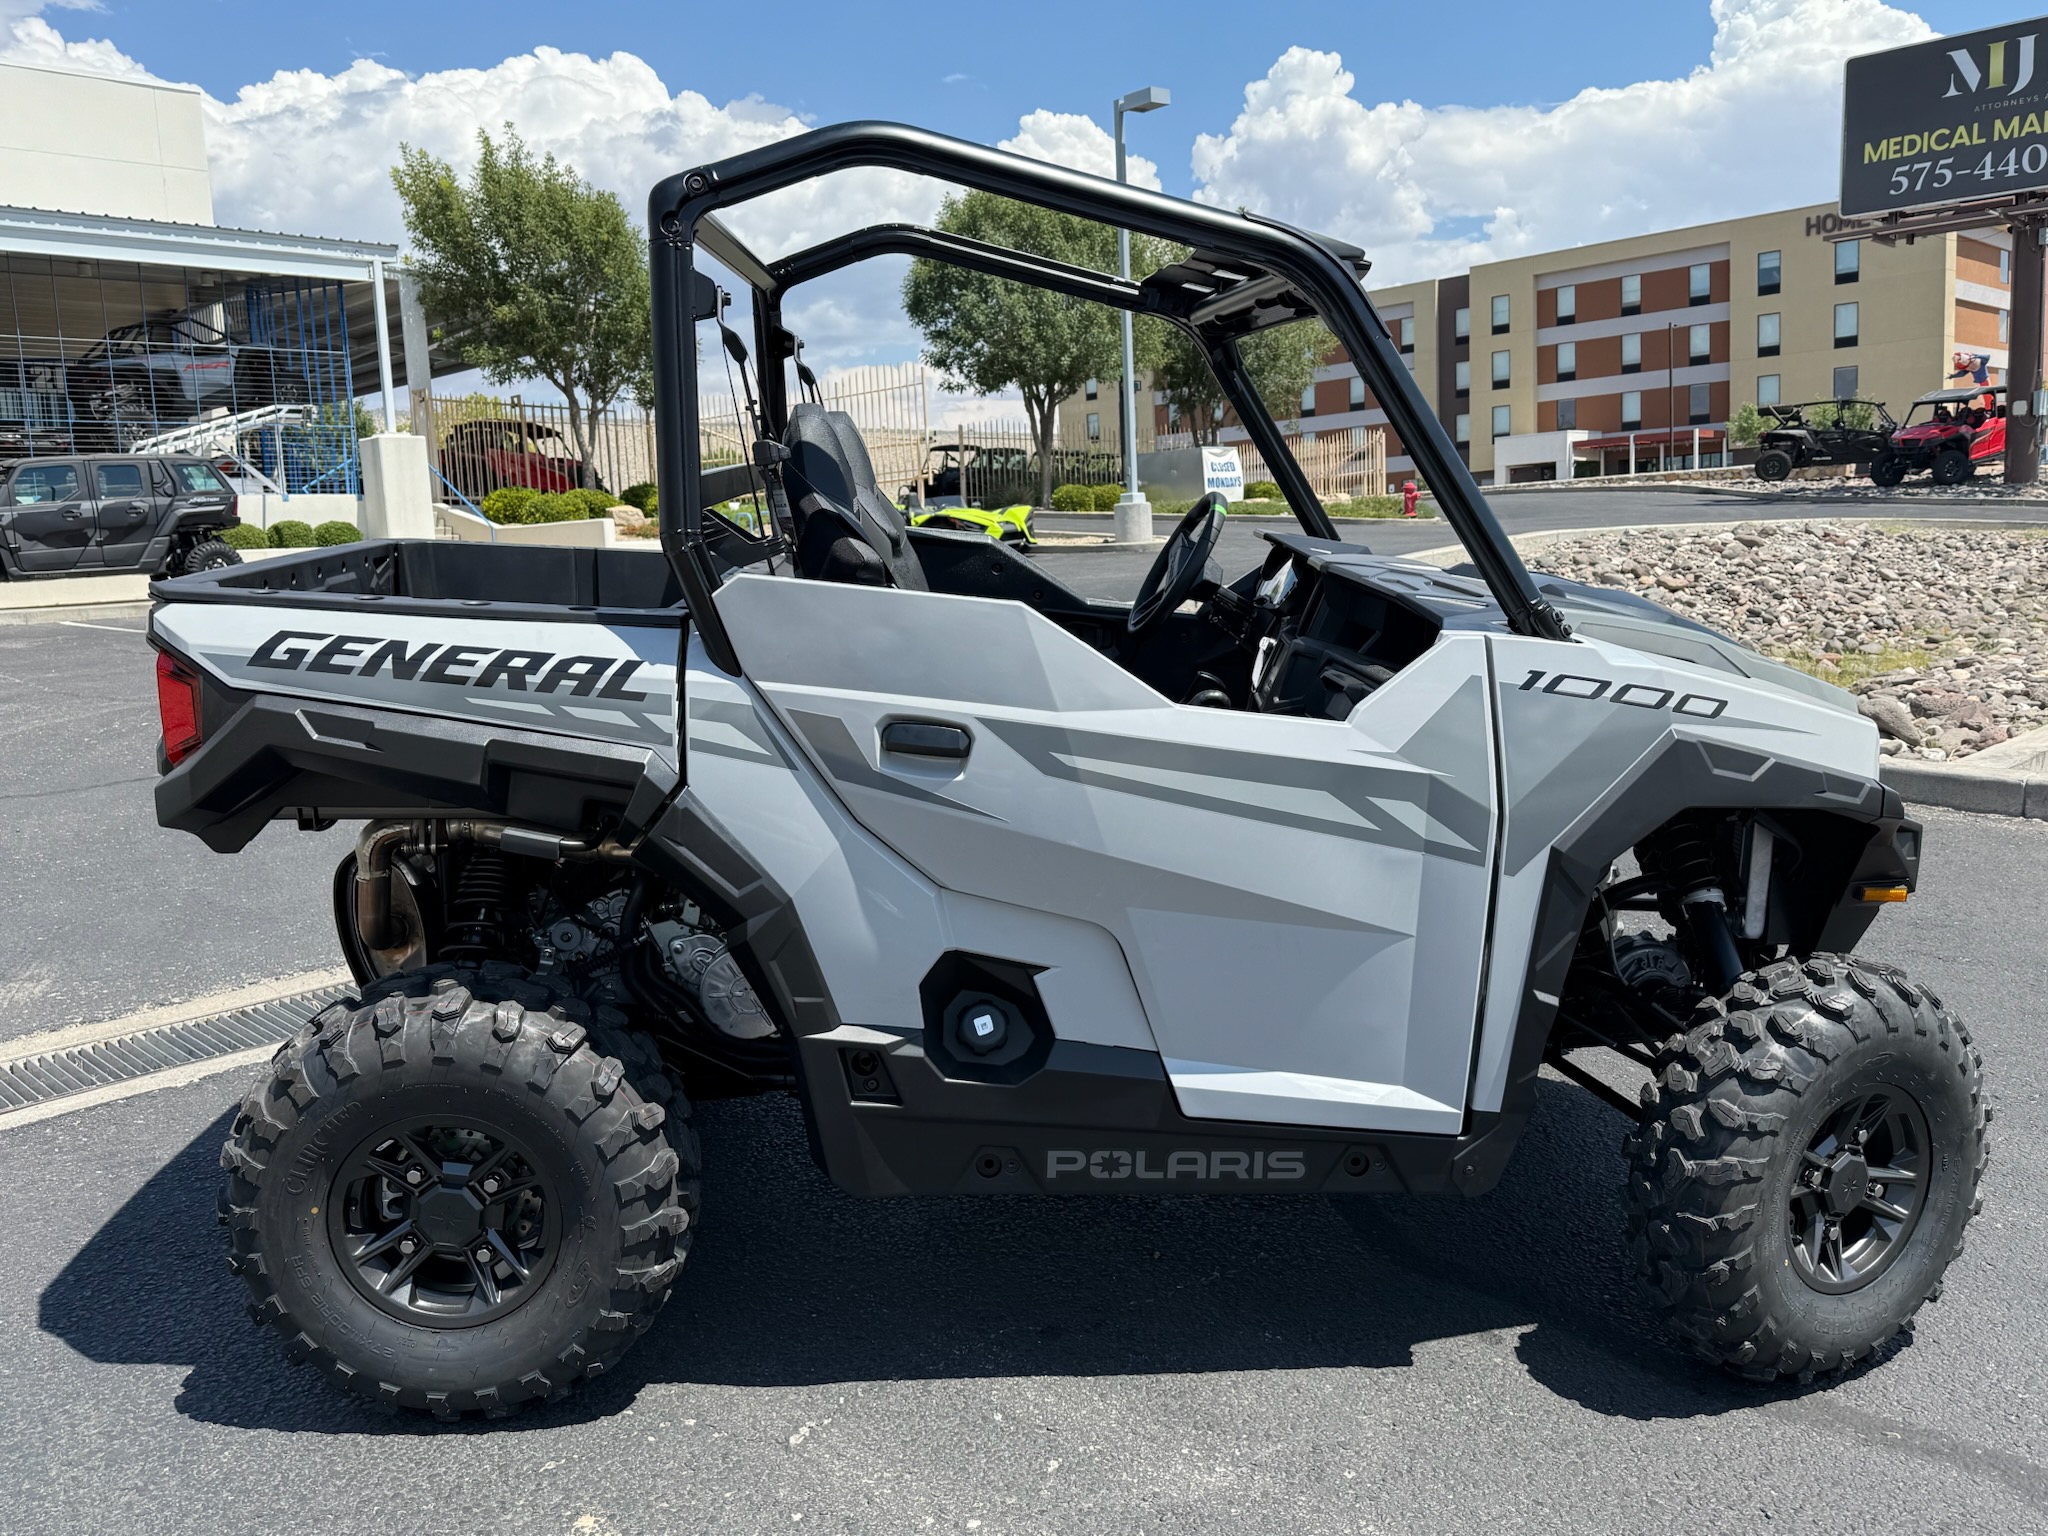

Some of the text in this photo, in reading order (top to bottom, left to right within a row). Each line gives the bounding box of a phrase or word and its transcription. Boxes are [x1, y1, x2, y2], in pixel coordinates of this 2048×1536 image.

[1973, 95, 2039, 113] ATTORNEYS
[1863, 122, 1986, 164] MEDICAL
[1889, 143, 2048, 195] 575-440
[1207, 476, 1242, 488] MONDAYS
[1210, 461, 1236, 472] CLOSED
[246, 629, 648, 702] GENERAL
[1518, 669, 1728, 719] 1000
[1046, 1150, 1306, 1179] POLARIS
